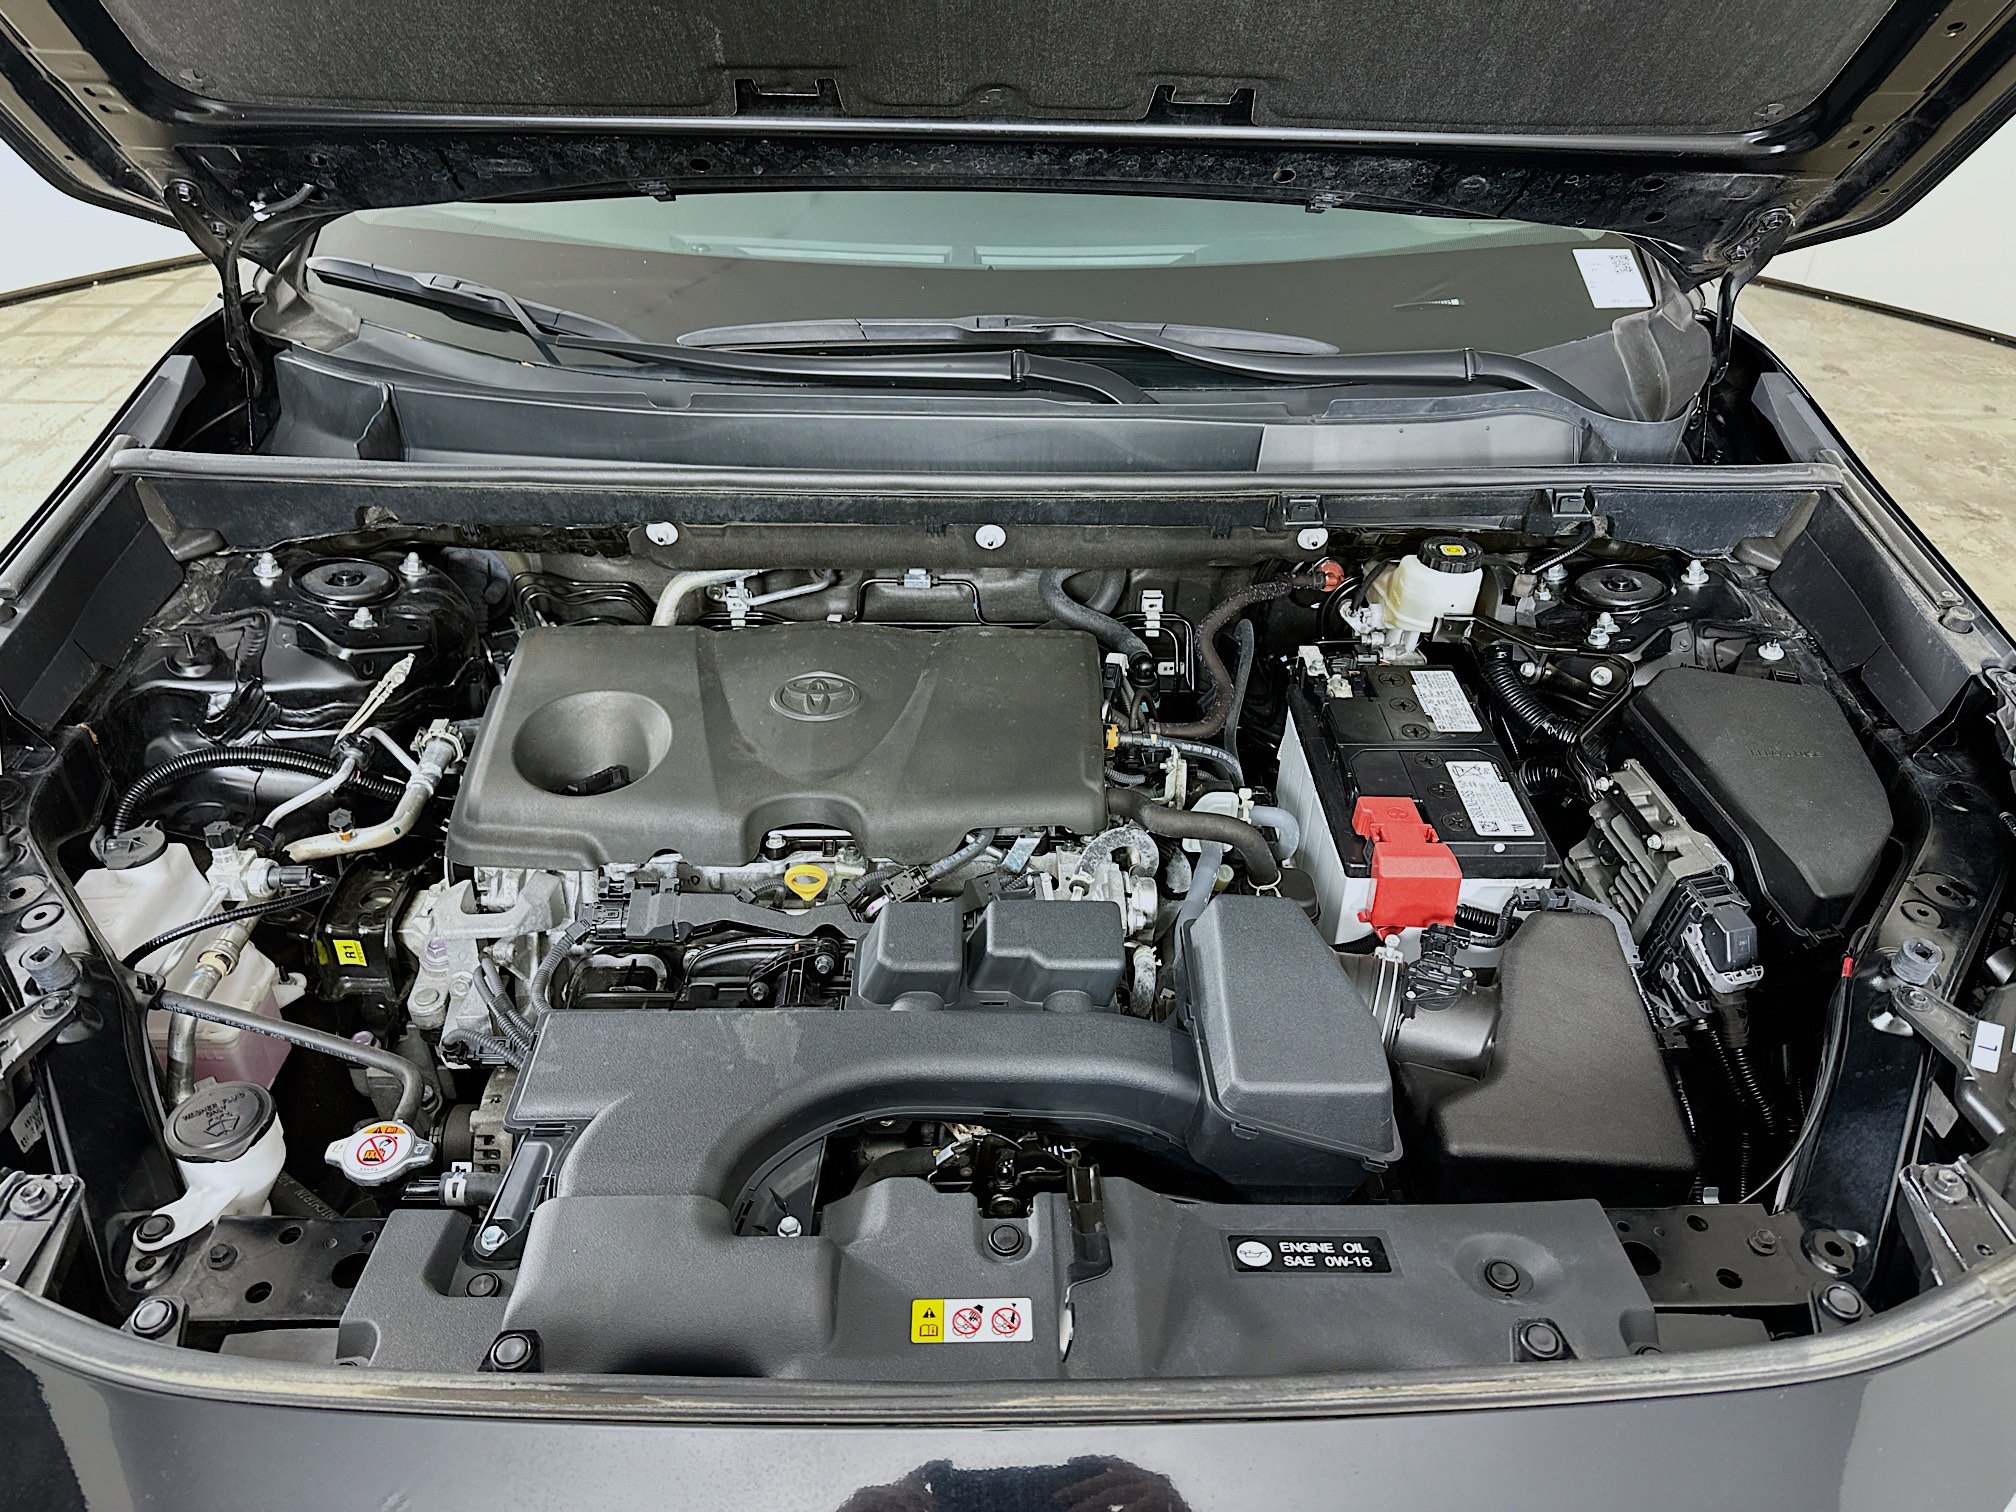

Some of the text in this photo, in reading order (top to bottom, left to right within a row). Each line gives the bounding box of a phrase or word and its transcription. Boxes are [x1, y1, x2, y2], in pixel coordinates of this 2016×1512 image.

[342, 945, 357, 959] R1
[182, 1092, 246, 1121] WASHER FLUID
[205, 1104, 227, 1118] ONLY
[1279, 1242, 1370, 1254] ENGINE OIL
[1283, 1255, 1373, 1268] SAE 0W-16
